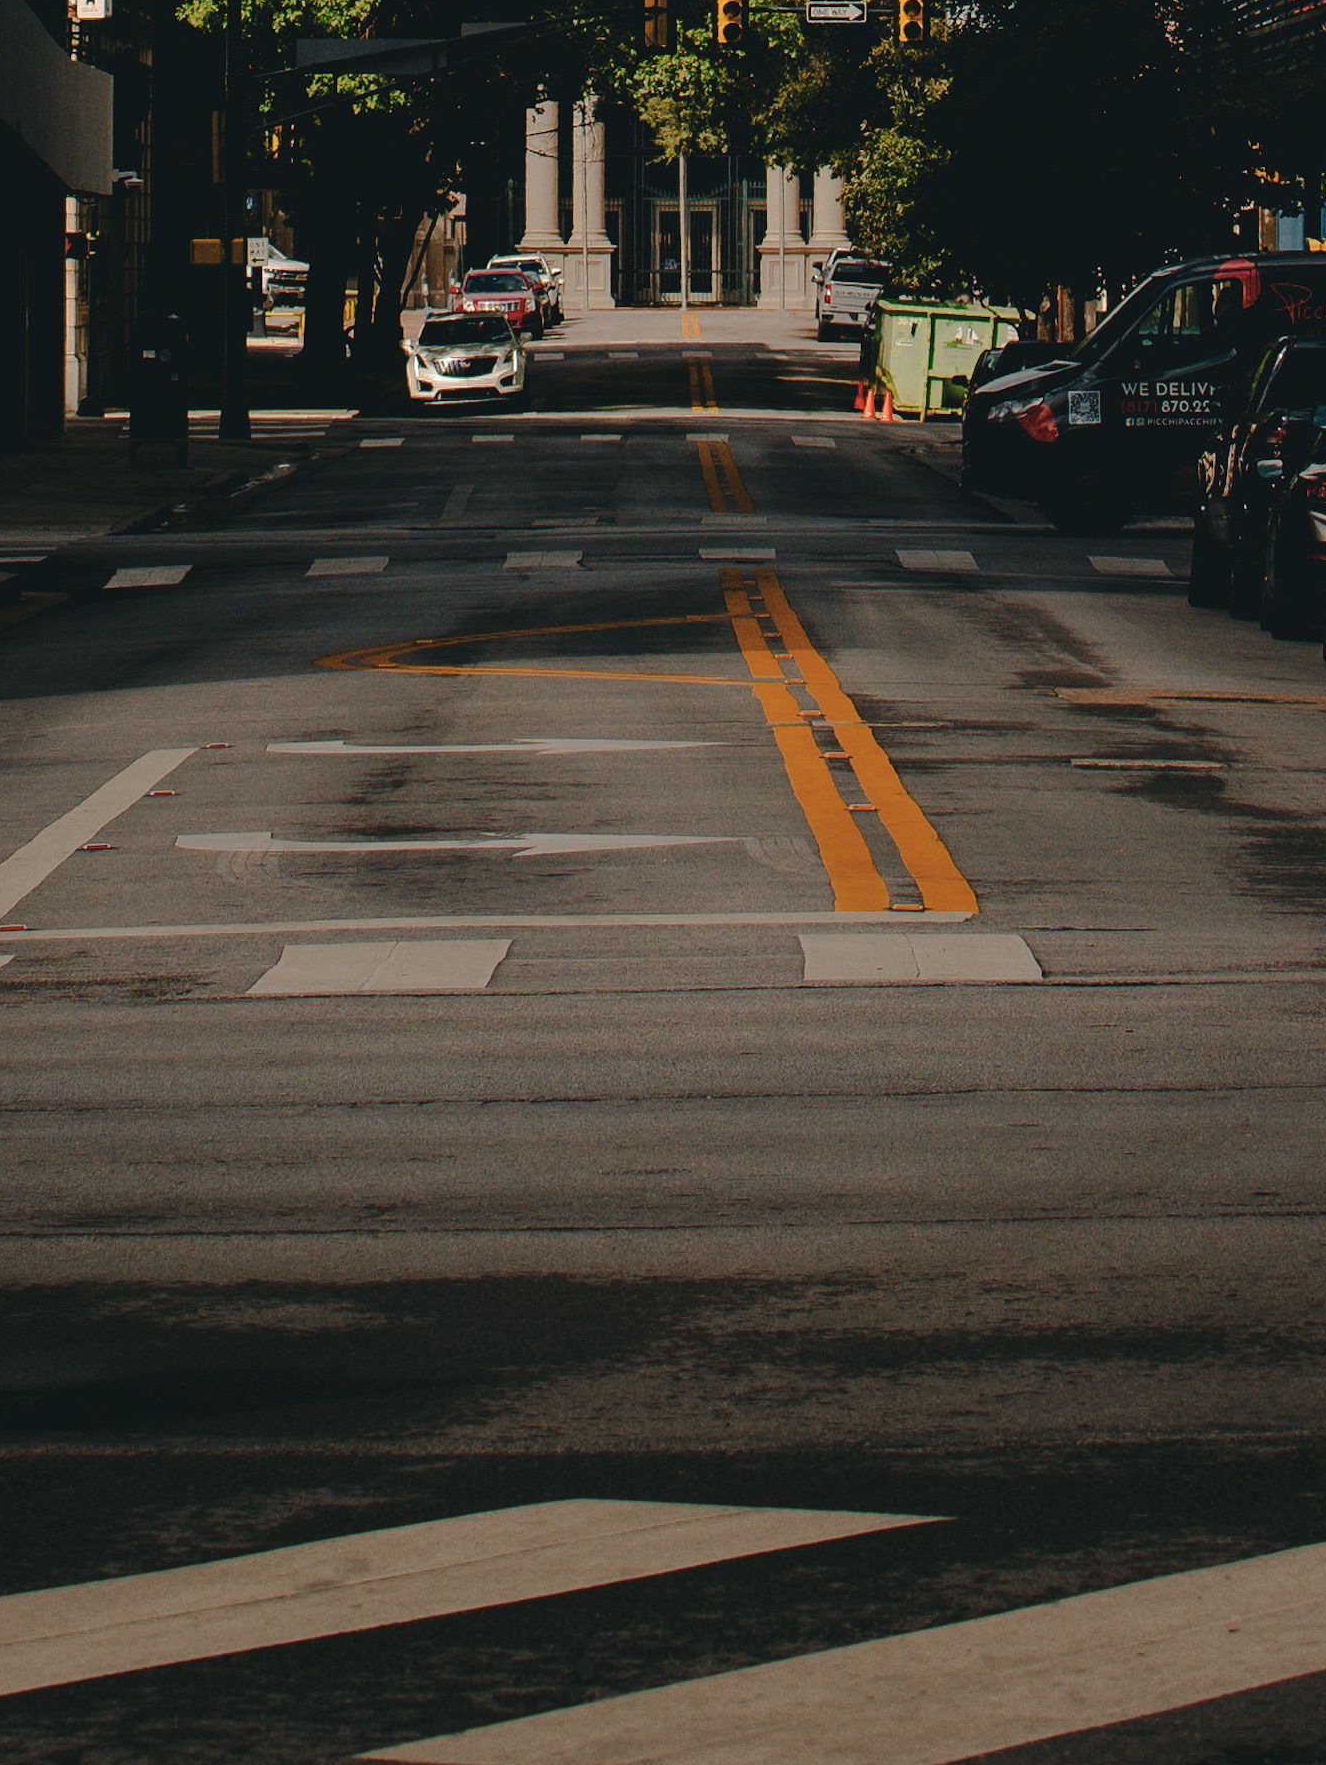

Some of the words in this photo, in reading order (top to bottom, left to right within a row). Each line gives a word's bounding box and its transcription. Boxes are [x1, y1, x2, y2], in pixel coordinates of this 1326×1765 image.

[812, 8, 829, 16] ONE
[831, 8, 848, 16] WAY
[1121, 382, 1150, 396] WE
